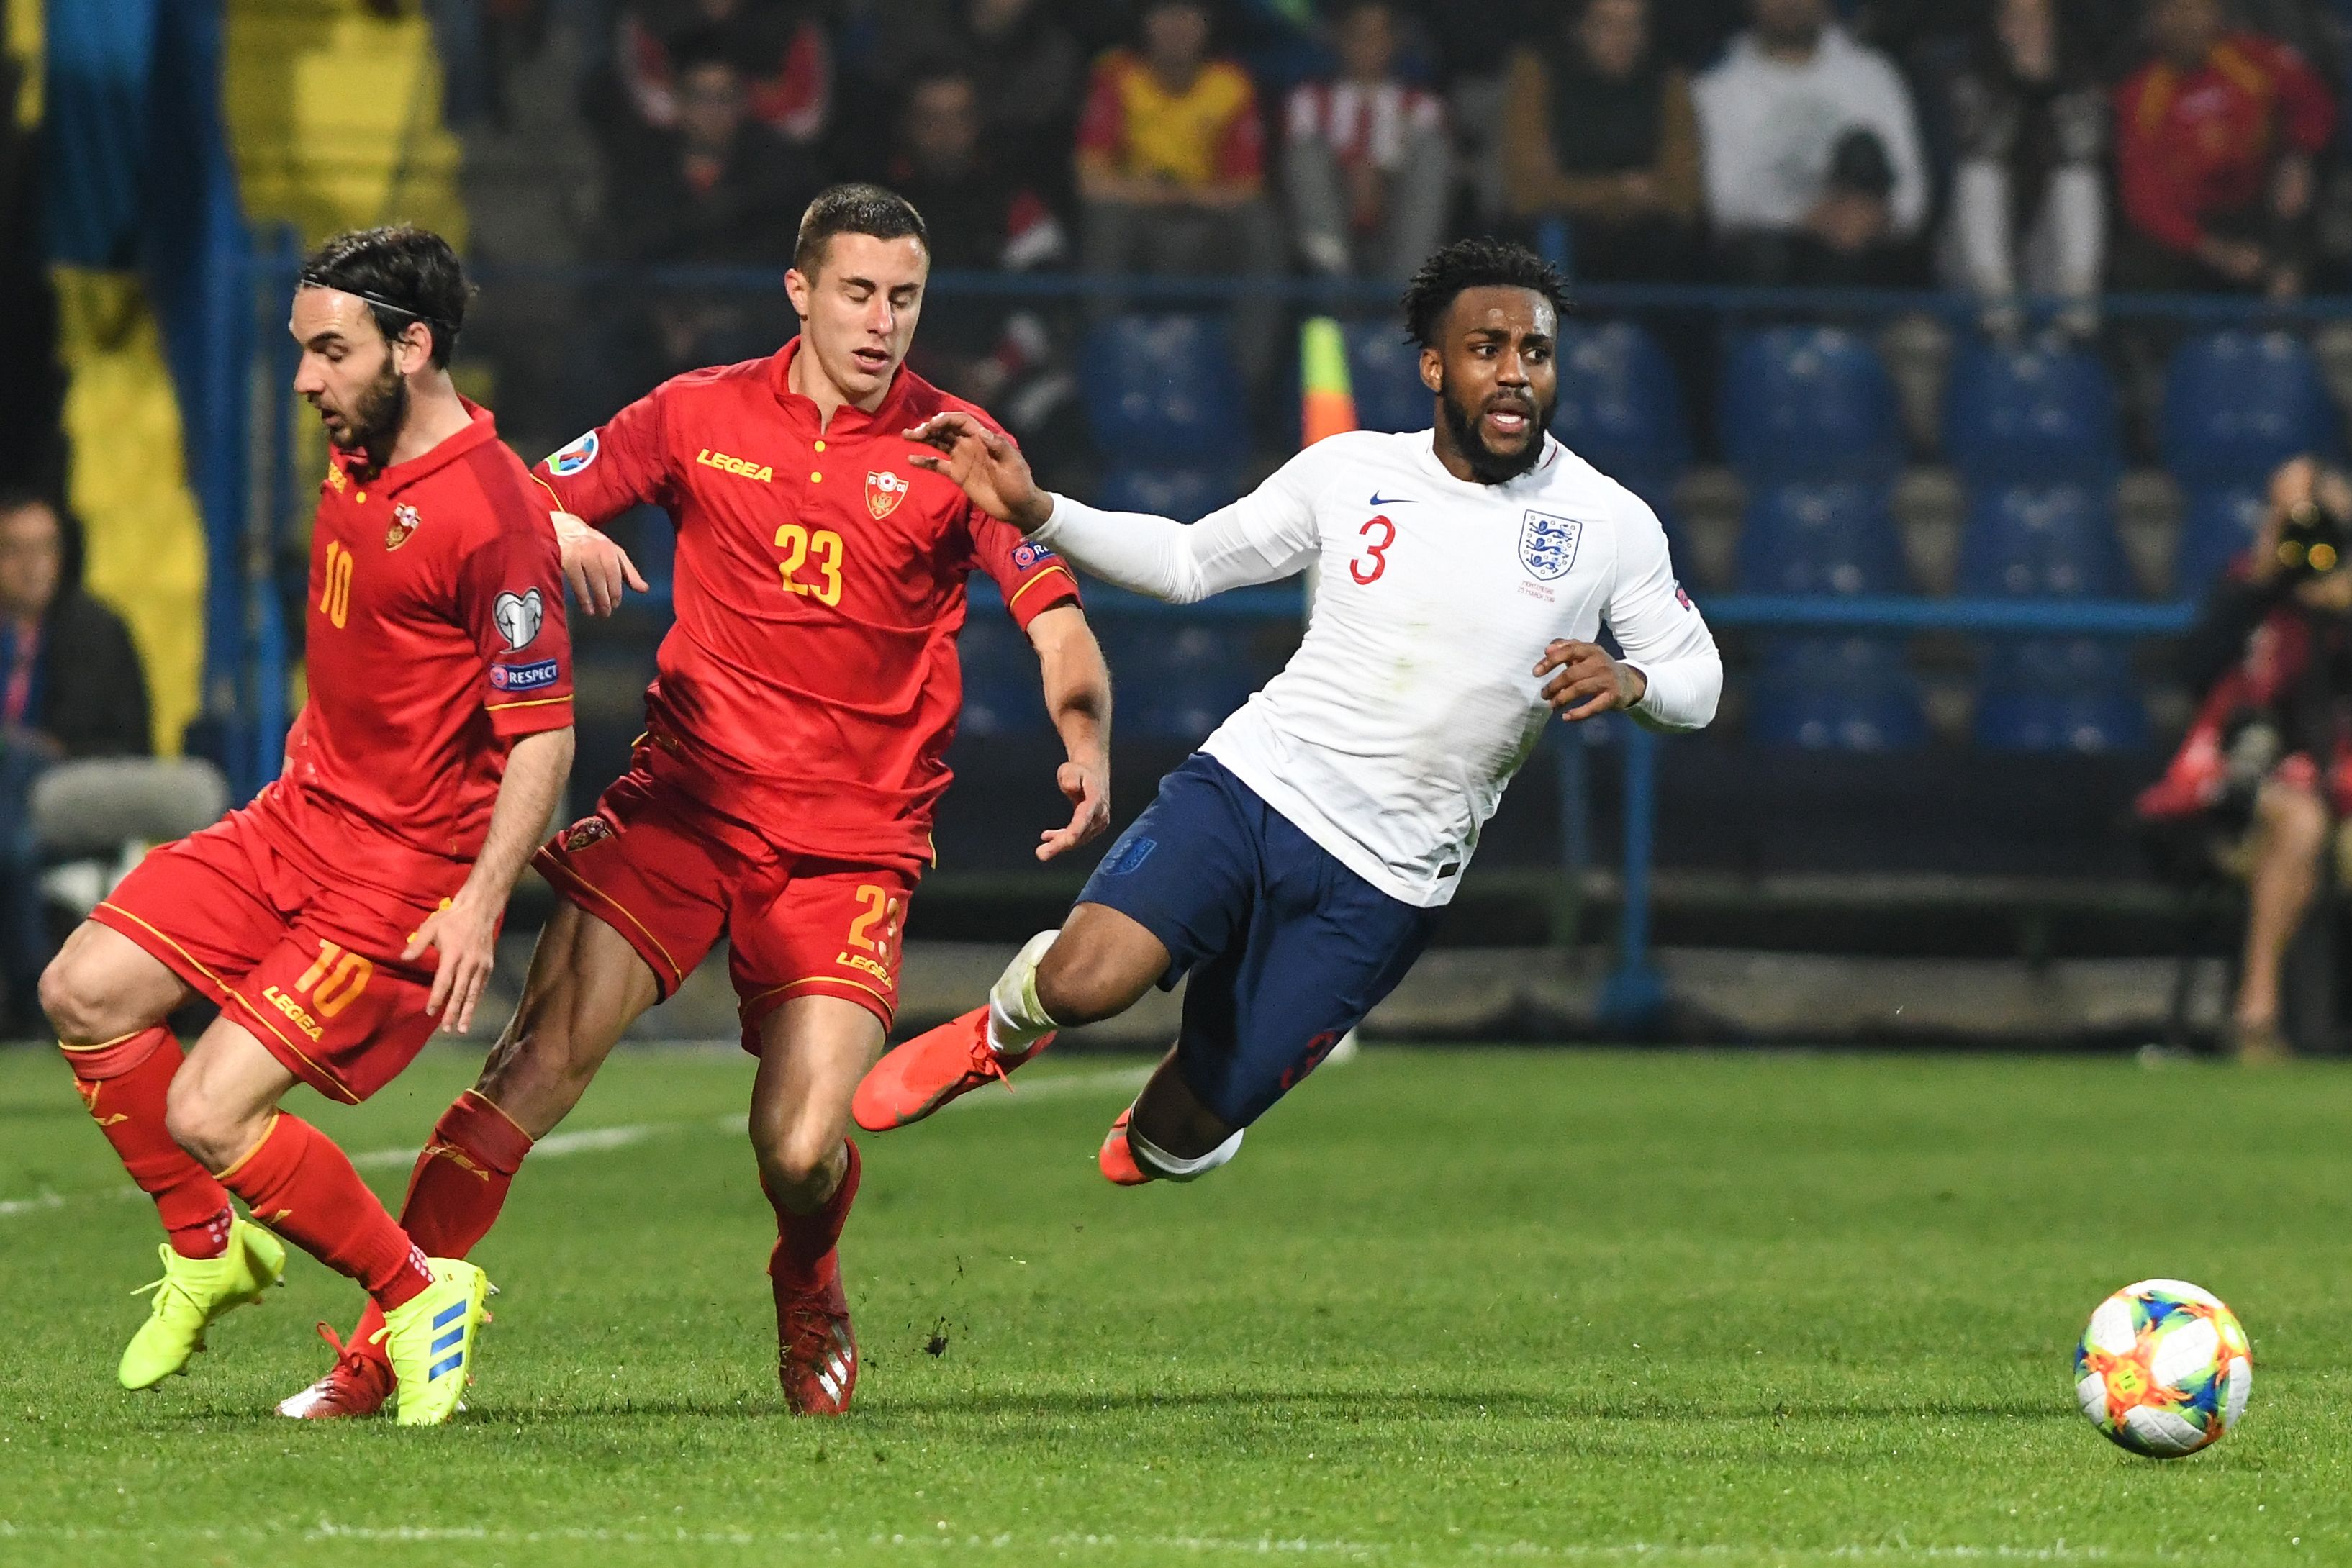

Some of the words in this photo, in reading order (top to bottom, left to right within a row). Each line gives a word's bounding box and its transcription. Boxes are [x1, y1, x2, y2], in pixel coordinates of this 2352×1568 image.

[696, 448, 774, 484] LEGEA
[774, 524, 843, 607] 23
[1350, 515, 1396, 585] 3
[320, 540, 353, 630] 10
[508, 664, 557, 684] RESPECT
[294, 938, 374, 1018] 10
[836, 951, 892, 991] LEGEA
[262, 985, 324, 1043] LEGEA
